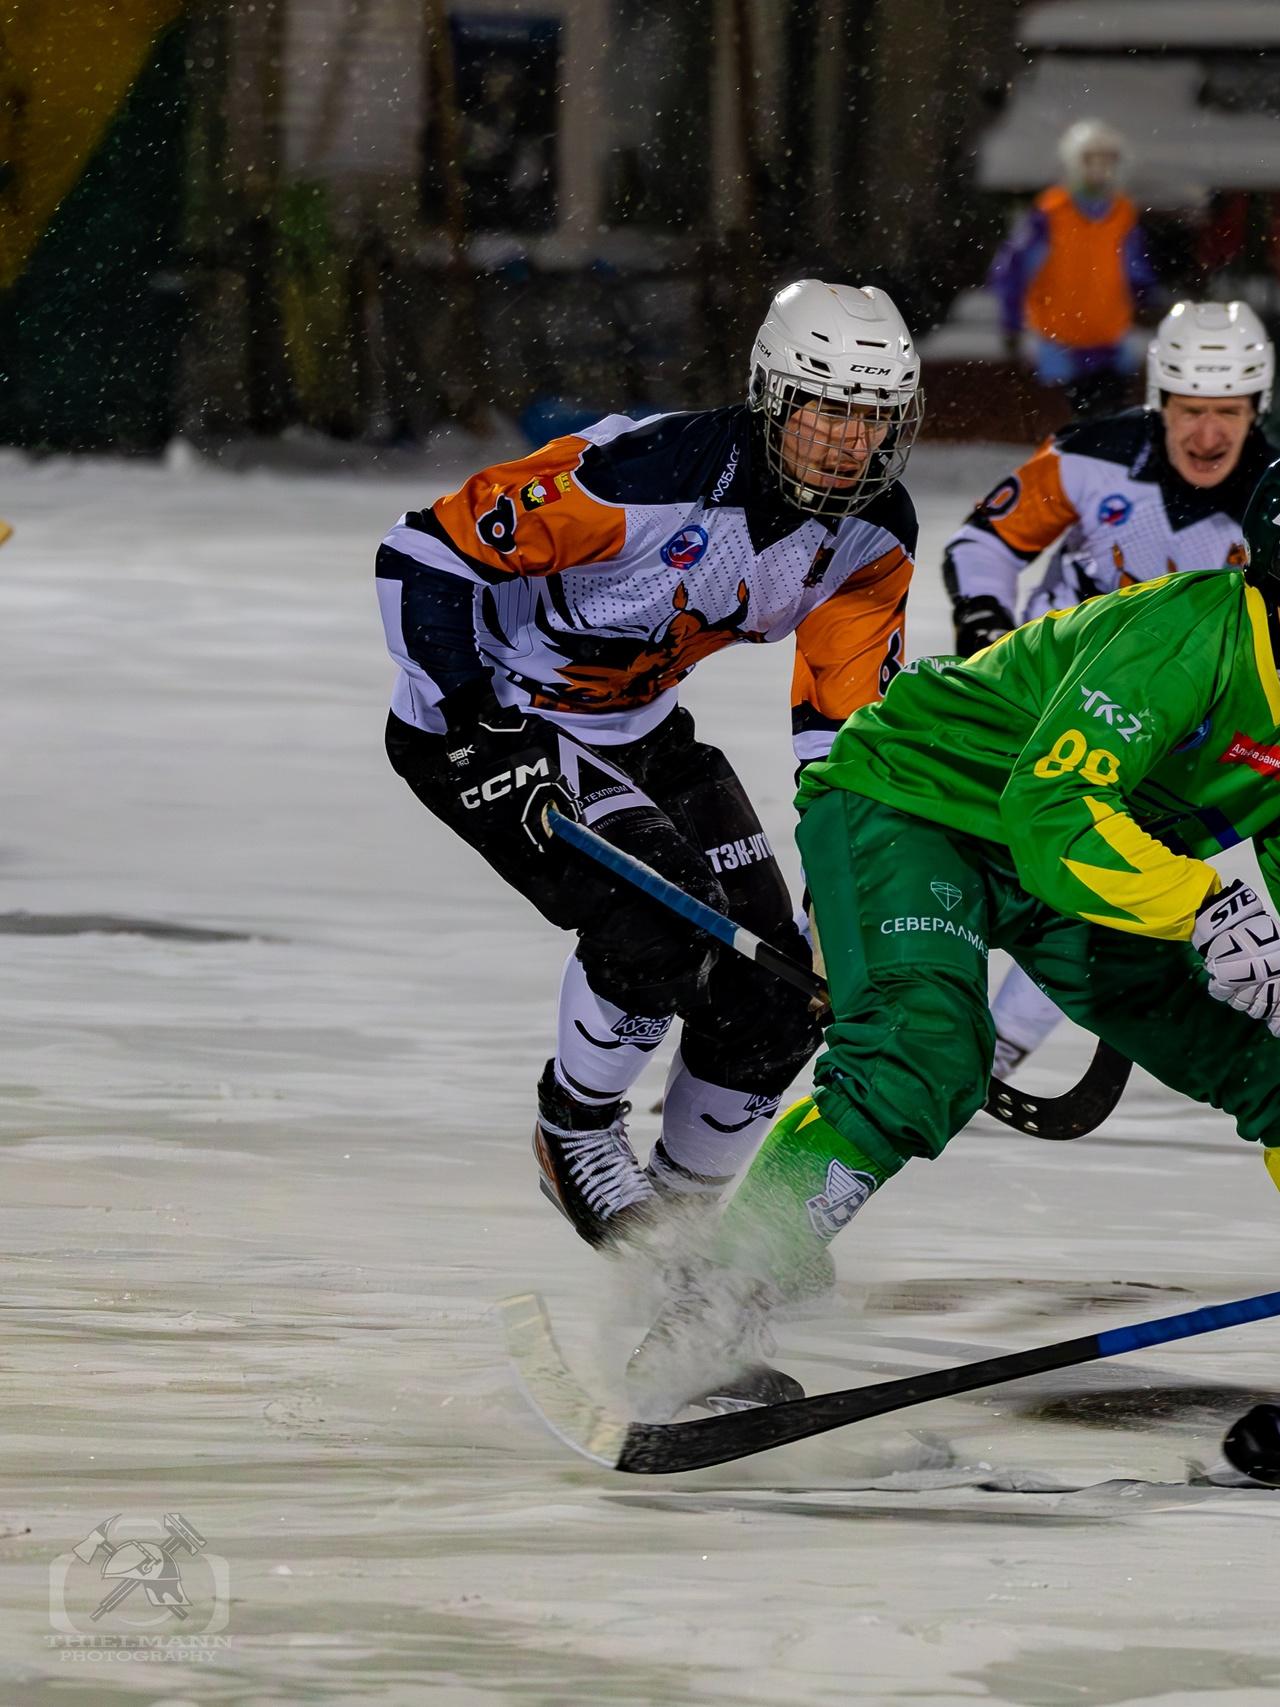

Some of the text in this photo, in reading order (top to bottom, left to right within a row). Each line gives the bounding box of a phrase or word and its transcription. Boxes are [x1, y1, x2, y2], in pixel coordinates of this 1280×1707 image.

[756, 339, 772, 359] CCM
[849, 364, 892, 376] CCM
[460, 757, 550, 809] CCM
[583, 784, 629, 803] ТЕХПРОМ
